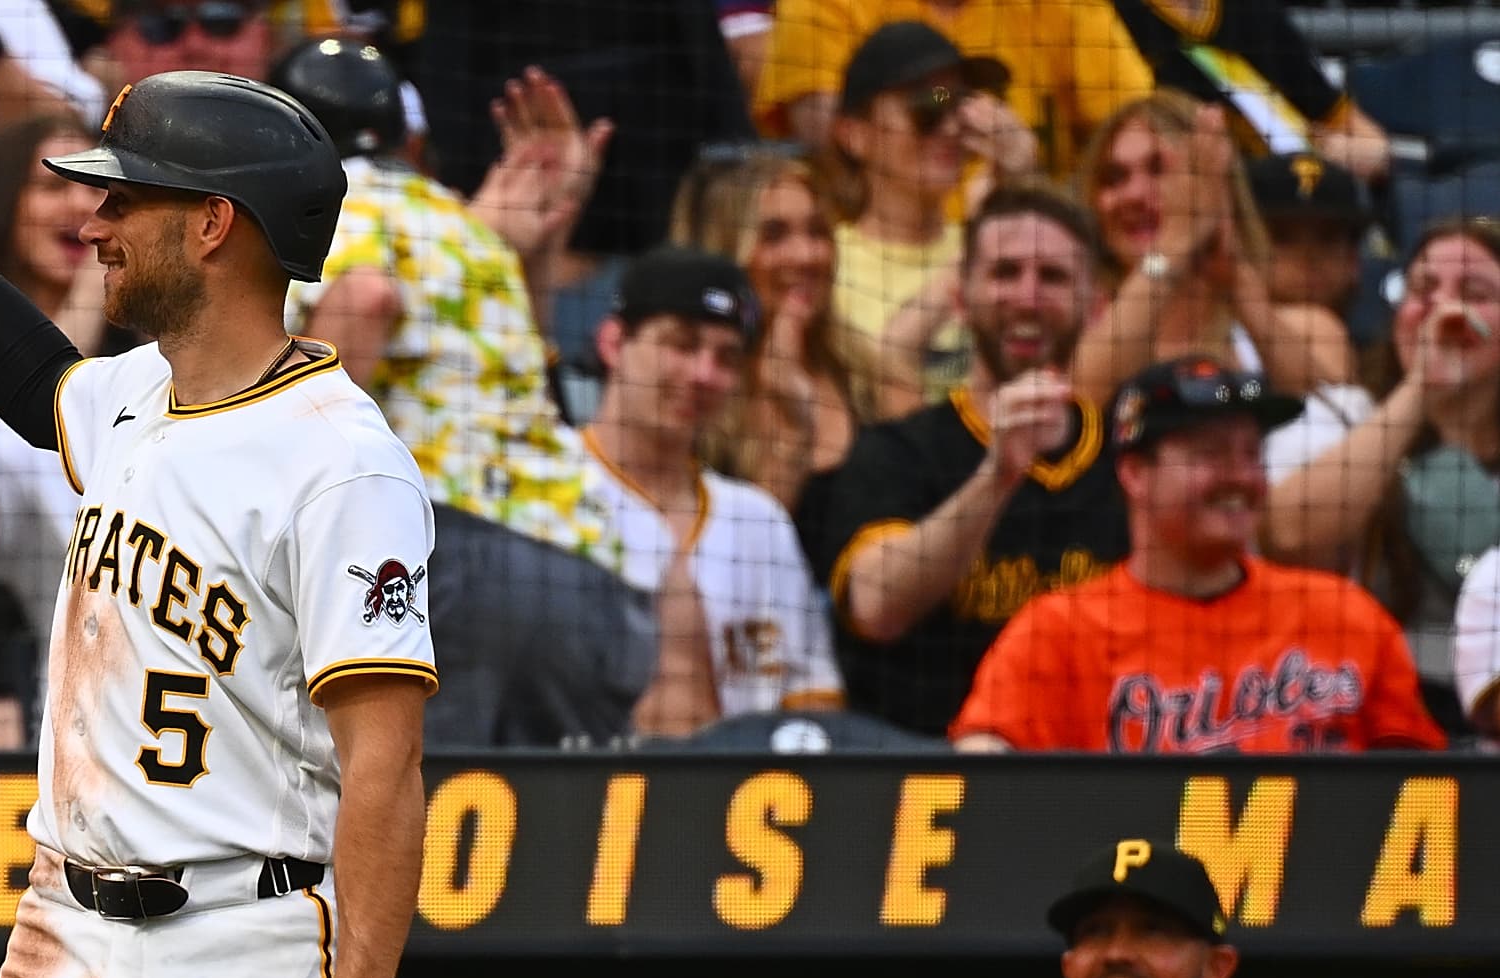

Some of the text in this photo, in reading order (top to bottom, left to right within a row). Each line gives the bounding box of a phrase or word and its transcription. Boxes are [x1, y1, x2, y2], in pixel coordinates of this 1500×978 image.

[66, 503, 252, 677] IRATES
[134, 668, 213, 788] 5
[1111, 648, 1363, 754] Orioles
[416, 769, 965, 930] OISE
[1113, 839, 1152, 882] P
